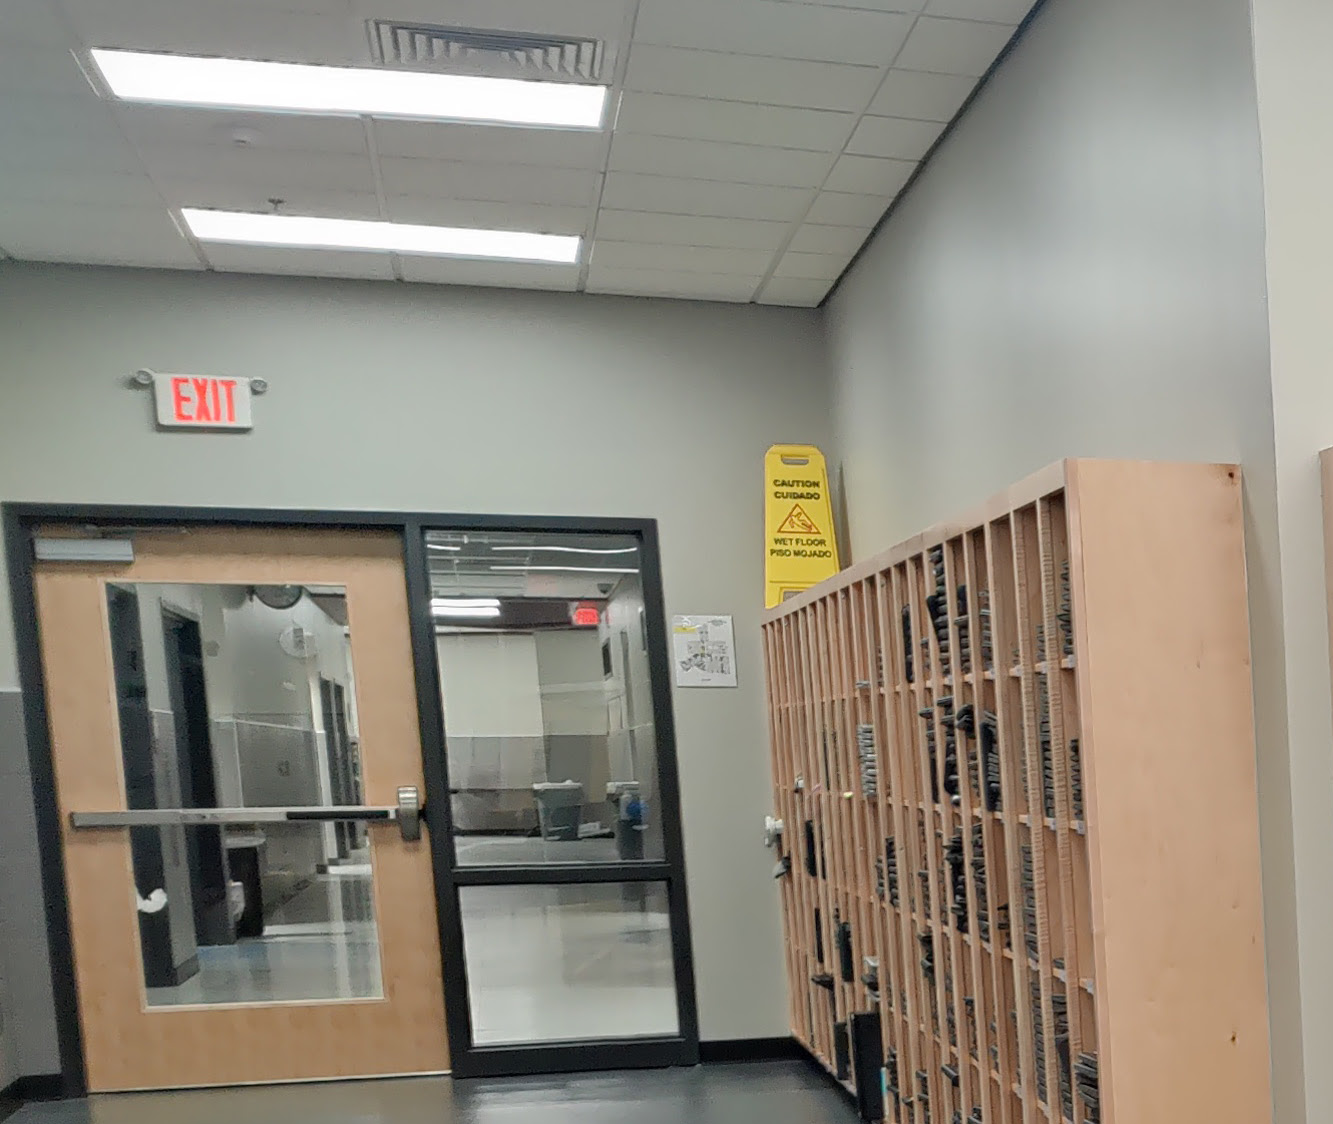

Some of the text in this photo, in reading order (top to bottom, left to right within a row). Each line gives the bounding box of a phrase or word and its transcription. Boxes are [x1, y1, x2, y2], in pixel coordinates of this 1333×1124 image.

[171, 377, 237, 423] EXIT
[773, 479, 820, 488] CAUTION
[774, 491, 820, 500] CUIDADO
[774, 537, 827, 547] WET FLOOR
[770, 549, 832, 558] PISO MOJADO
